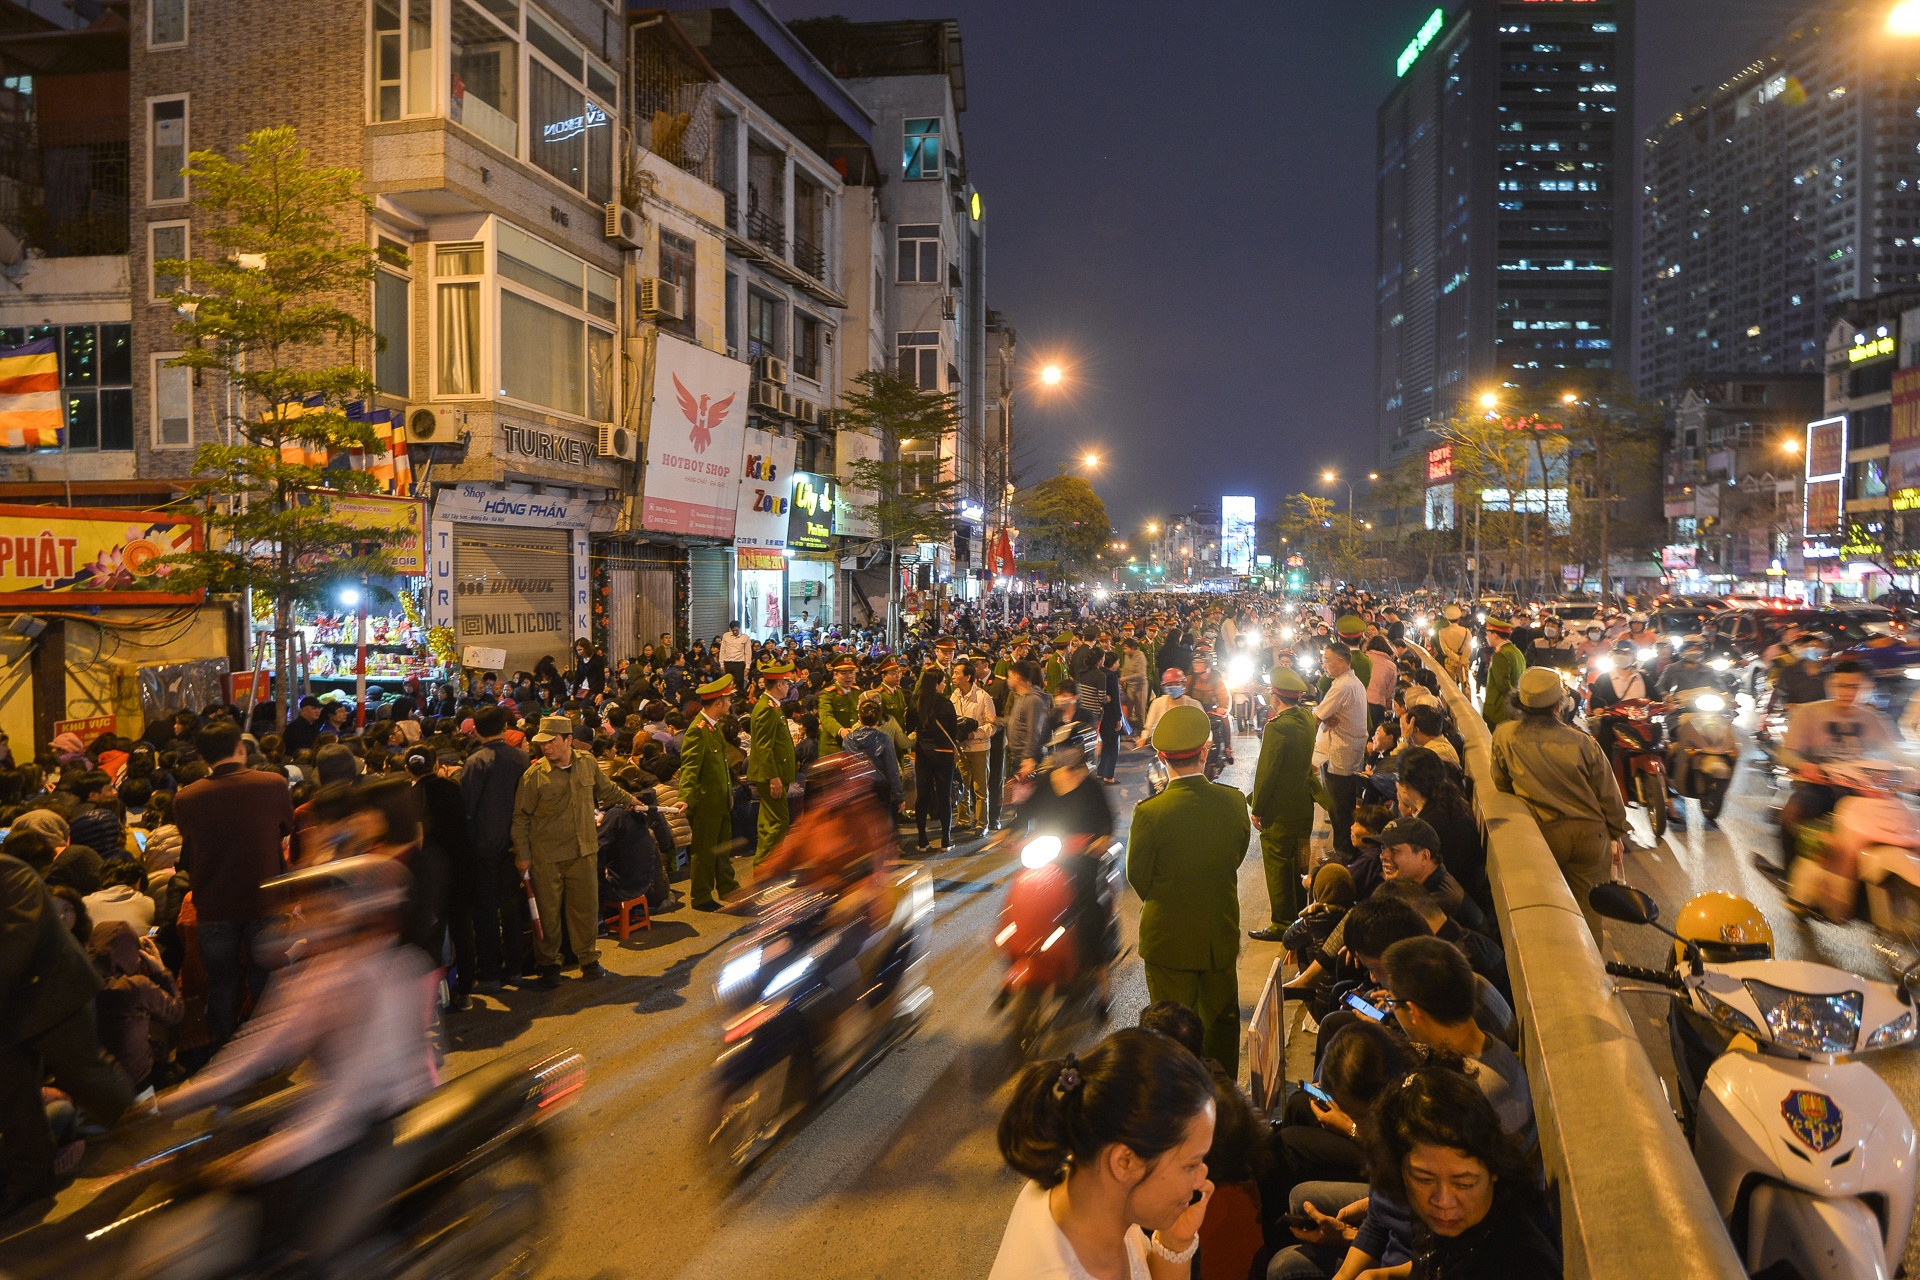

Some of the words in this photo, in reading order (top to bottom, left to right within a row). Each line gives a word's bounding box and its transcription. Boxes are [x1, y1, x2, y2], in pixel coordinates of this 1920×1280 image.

[502, 423, 595, 467] TURKEY
[662, 453, 704, 473] HOTBOY
[706, 463, 730, 478] SHOP
[745, 454, 776, 481] Kids
[463, 485, 485, 503] Shop
[753, 489, 787, 515] Zone
[484, 497, 527, 515] HỒNG
[528, 502, 567, 518] PHẤN
[0, 529, 78, 588] PHẬT
[391, 557, 417, 566] 2018
[485, 612, 562, 635] MULTICODE
[62, 721, 86, 732] KHU
